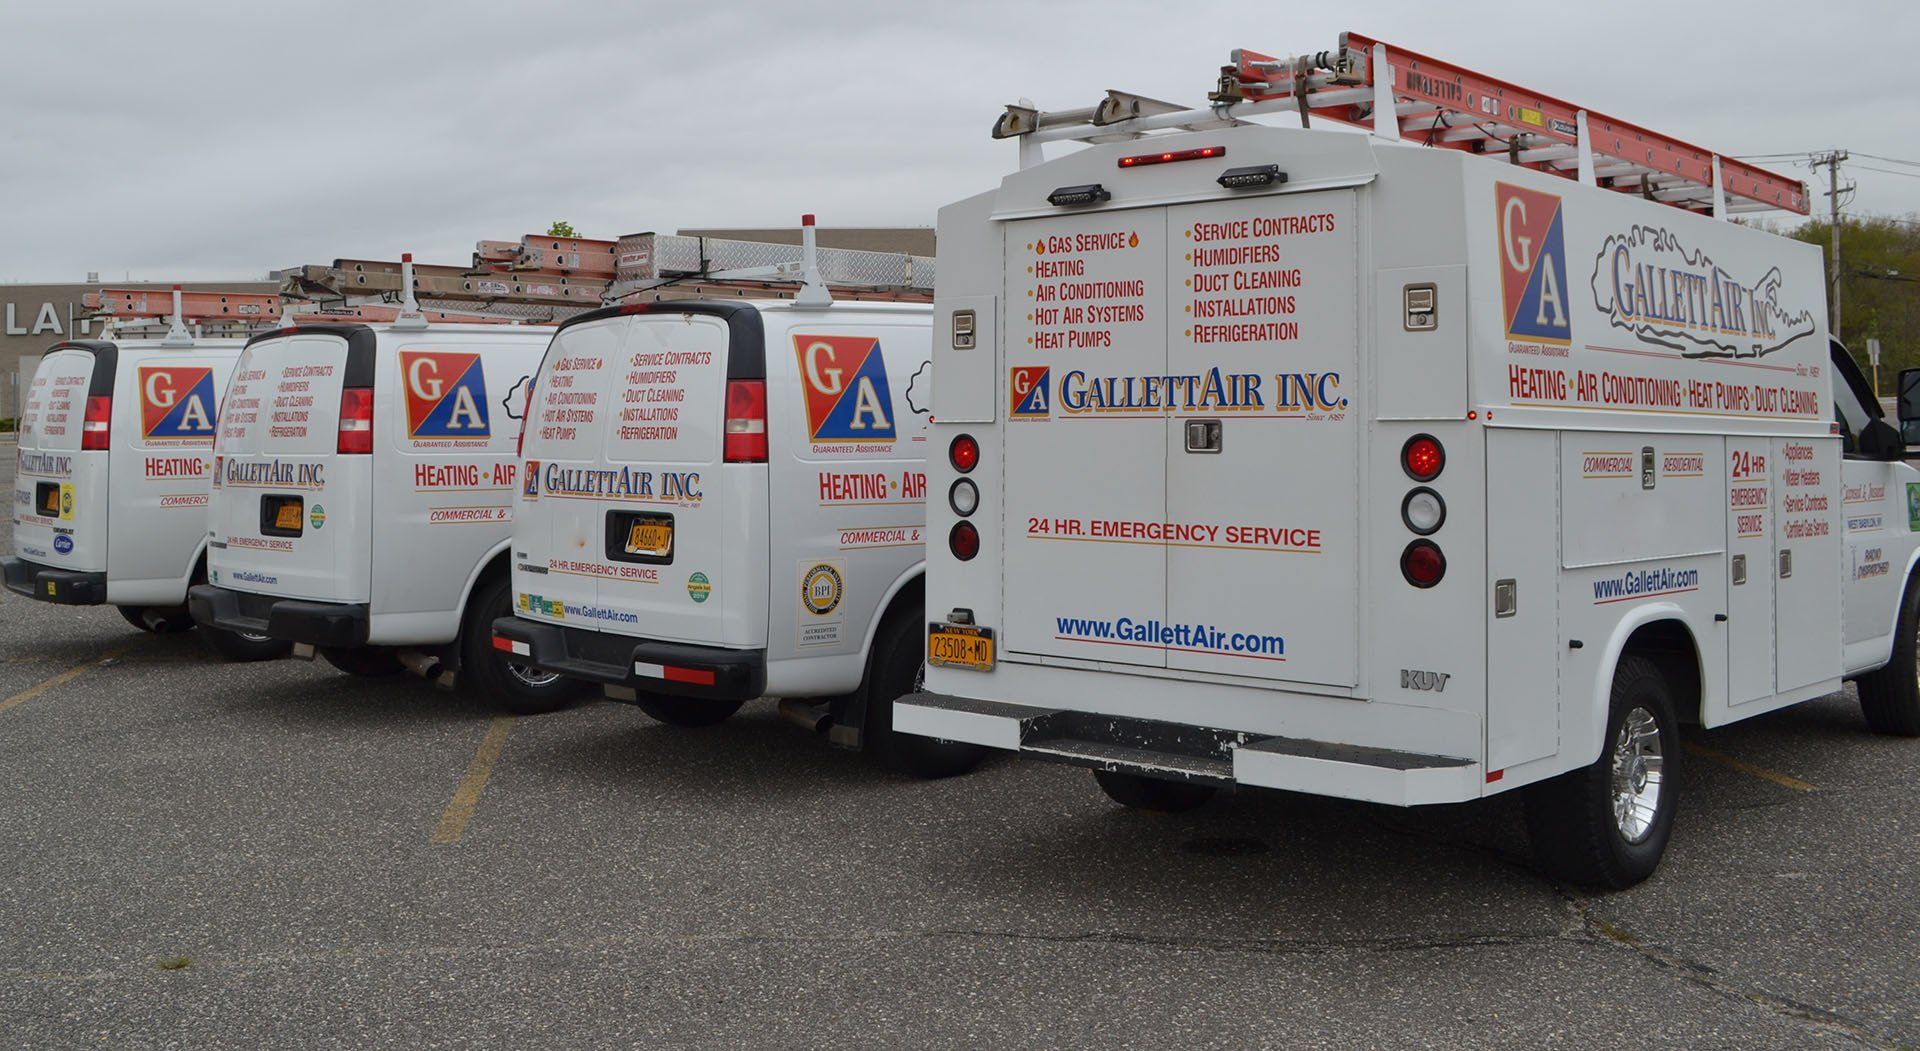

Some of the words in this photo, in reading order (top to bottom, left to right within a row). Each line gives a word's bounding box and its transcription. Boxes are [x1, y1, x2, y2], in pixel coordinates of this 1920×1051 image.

[1193, 221, 1249, 242] SERVICE
[1252, 213, 1335, 237] CONTRACTS
[1048, 236, 1072, 254] GAS
[1076, 232, 1125, 252] SERVICE
[1193, 244, 1280, 267] HUMIDIFIERS
[1035, 259, 1084, 278] HEATING
[1036, 284, 1056, 302] AIR
[1060, 280, 1144, 301] CONDITIONING
[1193, 273, 1229, 292] DUCT
[1233, 269, 1301, 291] CLEANING
[1035, 308, 1059, 325] HOT
[1063, 306, 1083, 325] AIR
[1087, 305, 1144, 324] SYSTEMS
[1193, 296, 1295, 318] INSTALLATIONS
[1035, 331, 1064, 349] HEAT
[1068, 330, 1111, 348] PUMPS
[1193, 322, 1298, 343] REFRIGERATION
[1508, 364, 1566, 401] HEATING
[1576, 369, 1598, 402] AIR
[1602, 371, 1681, 407] CONDITIONING
[1688, 379, 1714, 410] HEAT
[1716, 381, 1749, 412] PUMPS
[1755, 385, 1778, 413] DUCT
[415, 463, 478, 486] HEATING
[1583, 457, 1633, 472] COMMERCIAL
[1732, 450, 1750, 477] 24
[1752, 456, 1765, 473] HR
[818, 472, 887, 500] HEATING
[431, 509, 492, 521] COMMERCIAL
[840, 530, 906, 545] COMMERCIAL
[1028, 517, 1050, 534] 24
[1054, 519, 1086, 536] HR.
[1090, 520, 1219, 542] EMERGENCY
[1225, 526, 1321, 547] SERVICE
[571, 561, 618, 577] EMERGENCY
[620, 567, 657, 580] SERVICE
[815, 585, 830, 597] BPI
[1594, 568, 1699, 599] www.GallettAir.com
[564, 603, 638, 624] www.GallettAir.com
[1056, 617, 1285, 655] www.GallettAir.com
